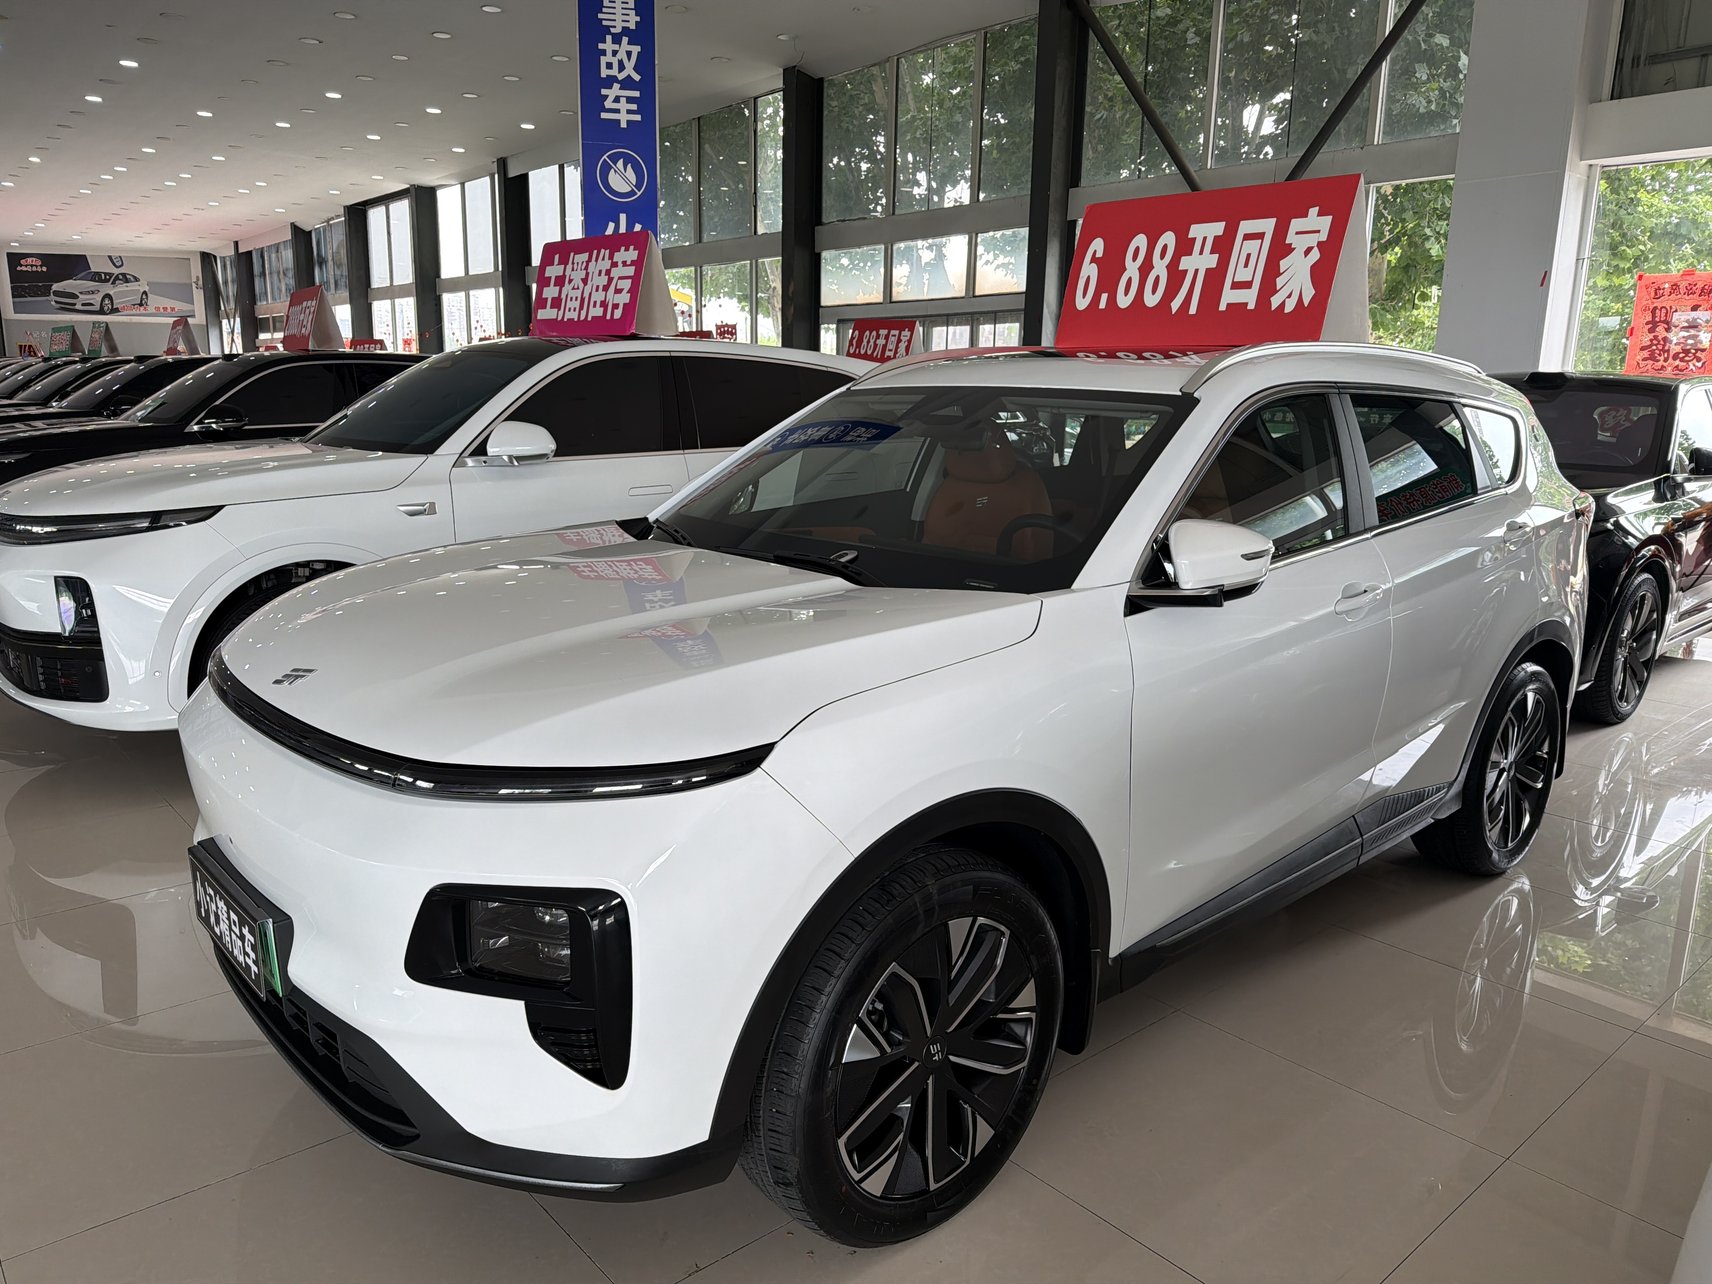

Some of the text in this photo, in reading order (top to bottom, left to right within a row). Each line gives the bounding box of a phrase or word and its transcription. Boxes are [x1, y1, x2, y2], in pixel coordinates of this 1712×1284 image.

[597, 0, 642, 128] 事故车
[537, 246, 639, 322] 主播推荐
[1074, 206, 1333, 315] 6.88开回家
[849, 328, 911, 359] 3.88开回家
[196, 871, 258, 980] 小记精品车
